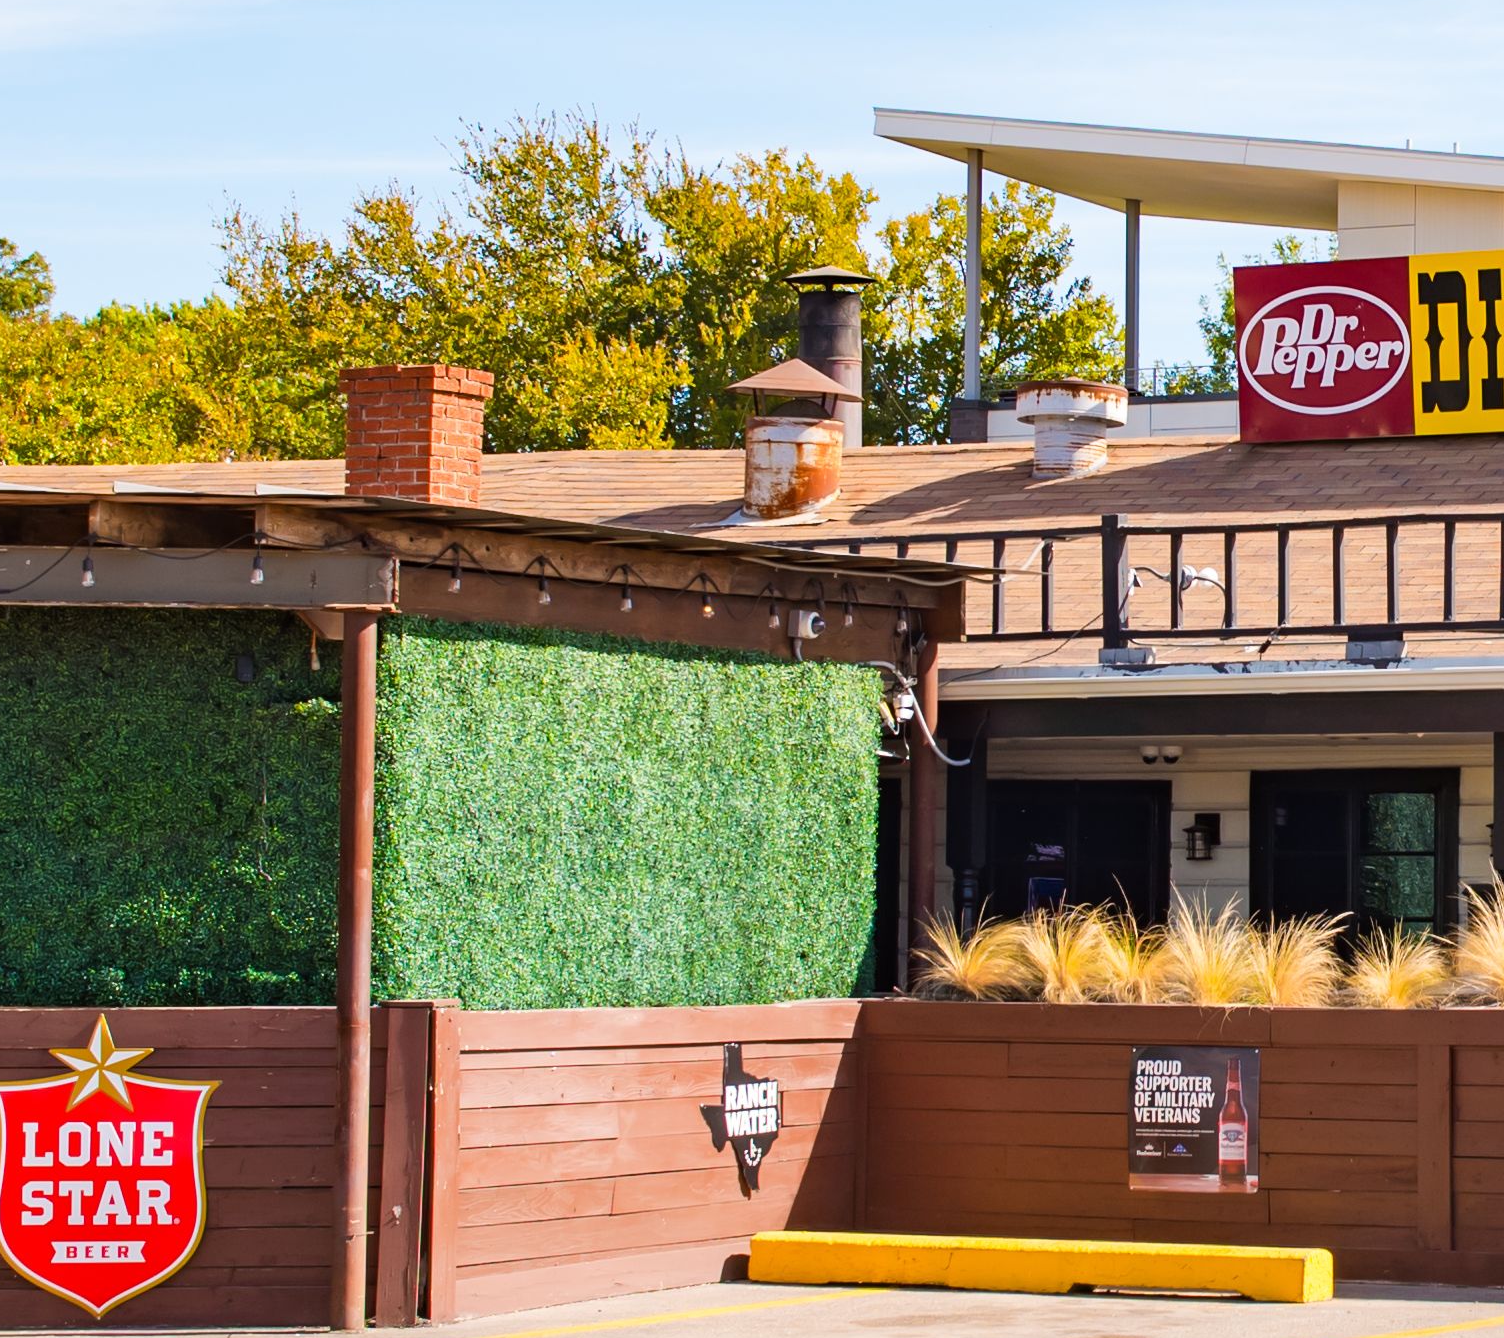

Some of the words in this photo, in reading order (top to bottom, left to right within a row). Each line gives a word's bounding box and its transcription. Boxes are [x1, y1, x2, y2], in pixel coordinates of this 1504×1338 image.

[1296, 303, 1358, 346] Dr
[1253, 317, 1403, 389] Pepper
[1136, 1060, 1182, 1076] PROUD
[725, 1081, 778, 1111] RANCH
[1135, 1076, 1212, 1092] SUPPORTER
[1134, 1091, 1152, 1107] OF
[1152, 1092, 1215, 1108] MILITARY
[725, 1107, 778, 1137] WATER
[1134, 1107, 1201, 1124] VETERANS
[21, 1121, 174, 1167] LONE
[21, 1180, 173, 1226] STAR
[65, 1245, 129, 1258] BEER
